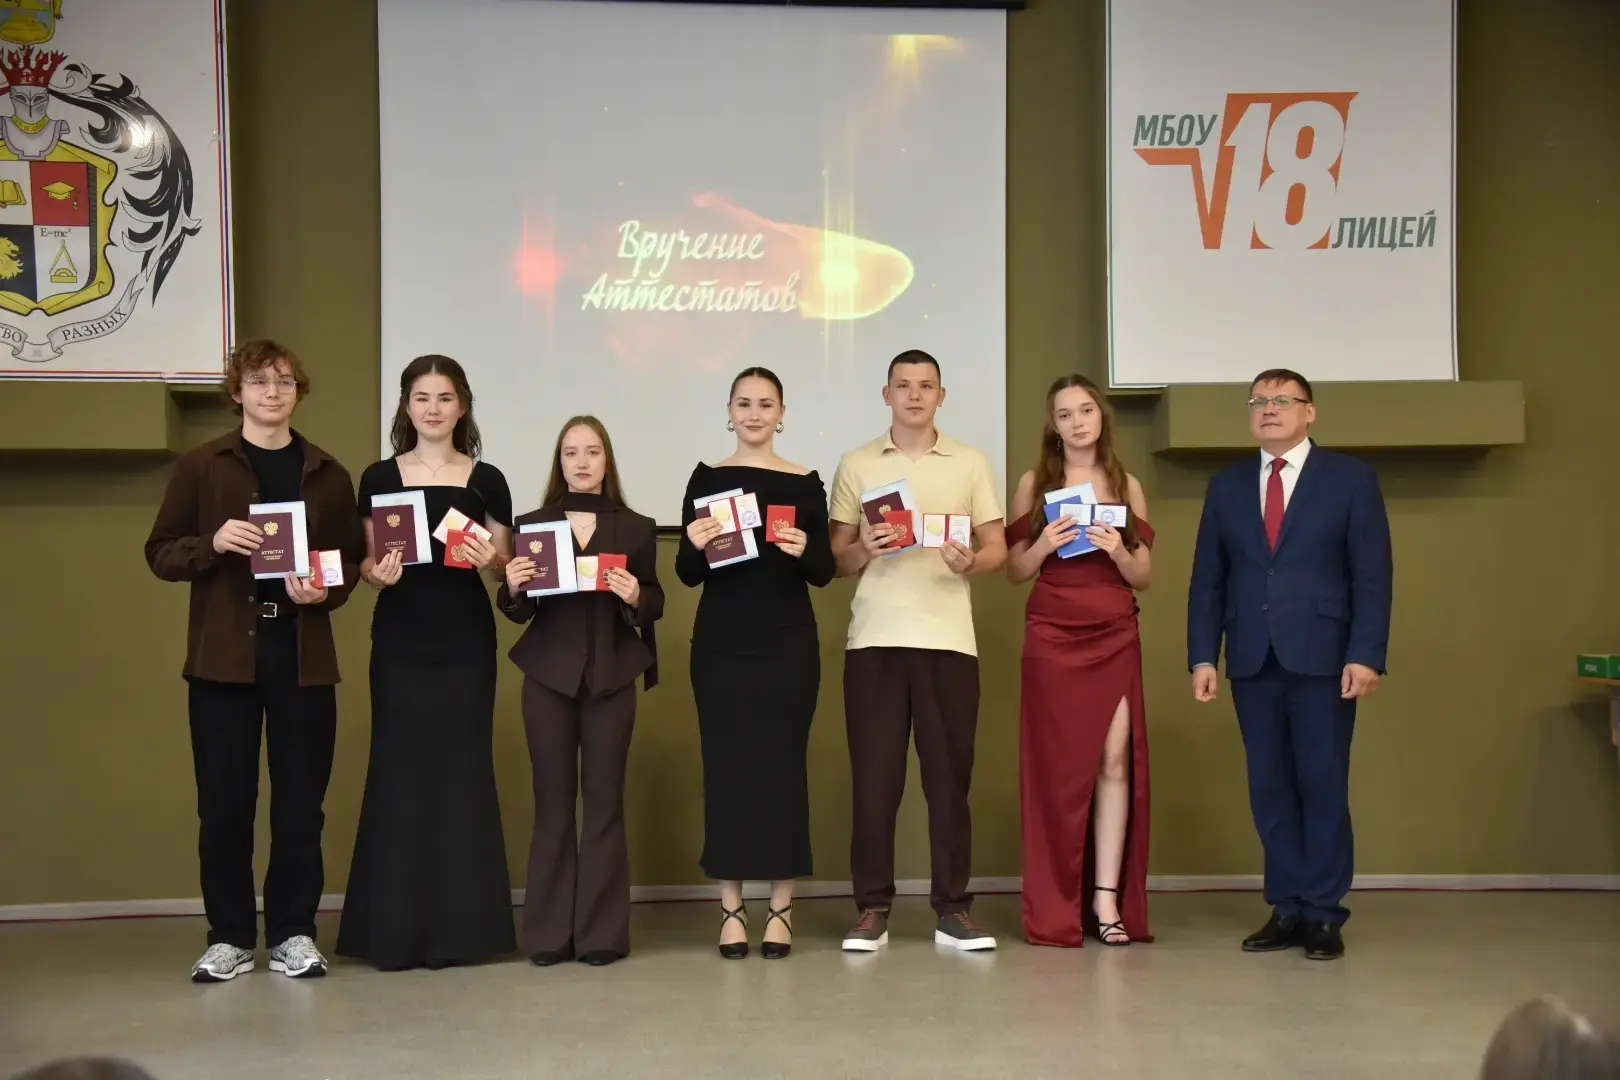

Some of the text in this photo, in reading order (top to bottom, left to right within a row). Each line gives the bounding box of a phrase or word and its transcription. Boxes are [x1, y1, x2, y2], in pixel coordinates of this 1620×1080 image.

[1133, 114, 1218, 147] МБОУ
[1220, 100, 1346, 250] 18
[617, 219, 765, 279] Вручение
[1332, 208, 1437, 251] ЛИЦЕЙ
[581, 271, 800, 312] Аттестатов
[61, 307, 127, 341] РАЗНЫХ
